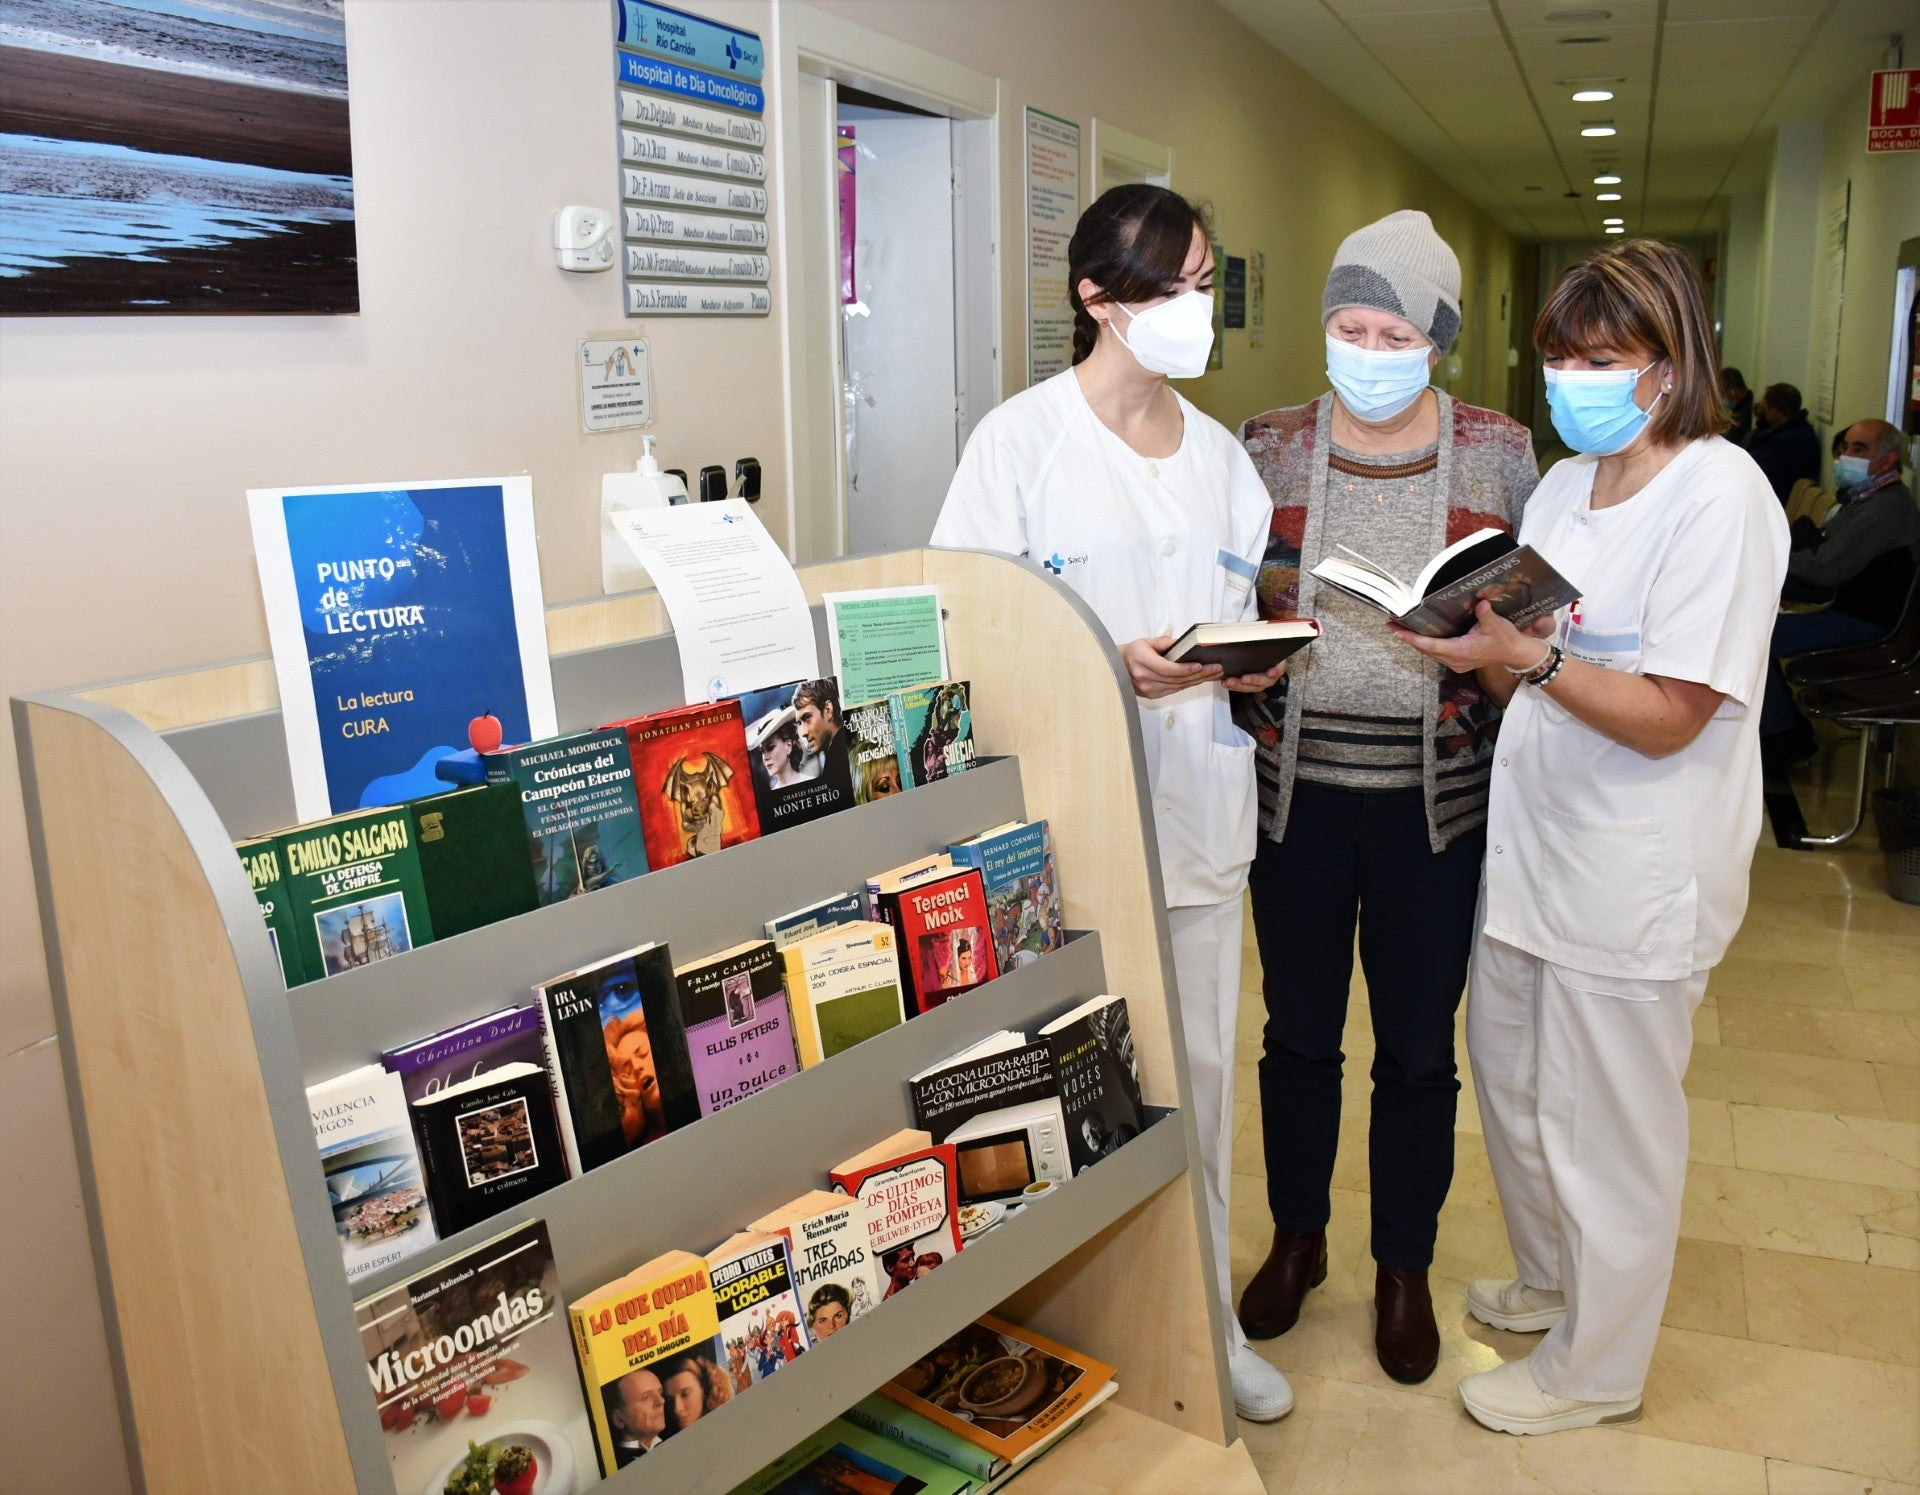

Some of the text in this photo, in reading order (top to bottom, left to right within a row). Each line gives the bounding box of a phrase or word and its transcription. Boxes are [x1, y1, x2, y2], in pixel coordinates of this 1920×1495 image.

[656, 18, 686, 37] Hospital
[670, 39, 696, 57] Carrión
[629, 59, 673, 86] Hospital
[675, 72, 687, 89] de
[1871, 129, 1903, 140] BOCA
[317, 557, 395, 584] PUNTO
[1067, 554, 1089, 566] Sacyl
[1460, 556, 1521, 594] ANDREWS
[322, 587, 349, 610] de
[324, 605, 425, 635] LECTURA
[337, 688, 414, 711] La lectura
[342, 717, 391, 738] CURA
[639, 711, 733, 743] JONATHAN STROUD
[520, 737, 623, 769] MICHAEL MOORCOCK
[942, 739, 976, 767] SUECIA
[534, 759, 593, 785] Crónicas
[594, 753, 615, 771] del
[946, 761, 977, 774] INFIERNO
[521, 767, 631, 803] Campeón Eterno
[783, 783, 828, 802] CHARLES FRAZIER
[538, 785, 622, 814] EL ETERNO
[580, 797, 623, 816] OBSIDIANA
[773, 788, 840, 818] MONTE FRÍO
[532, 829, 544, 840] EL
[581, 818, 592, 830] EN
[605, 805, 634, 822] ESPADA
[286, 819, 409, 876] EMILIO SALGARI
[983, 831, 1041, 858] BERNARD CORNWELL
[986, 860, 994, 872] El
[995, 858, 1005, 870] rey
[1006, 853, 1016, 865] del
[1017, 845, 1042, 861] invierno
[321, 861, 383, 886] LA DEFENSA
[326, 872, 381, 896] DE CHIPRE
[912, 882, 971, 915] Terenci
[924, 906, 965, 931] Moix
[810, 957, 893, 983] UNA ODISEA ESPACIAL
[554, 988, 576, 1007] IRA
[811, 980, 826, 991] 2001
[844, 978, 897, 995] ARTHUR CLARKE
[557, 996, 594, 1022] LEVIN
[416, 1017, 523, 1065] Christina Dodd
[706, 1017, 780, 1057] ELLIS PETERS
[1060, 1050, 1100, 1079] POR SI LAS
[920, 1084, 936, 1099] LA
[935, 1069, 977, 1093] COCINA
[933, 1063, 1040, 1106] CON MICROONDAS II
[1063, 1065, 1102, 1098] VOCES
[312, 1094, 377, 1122] VALENCIA
[461, 1097, 484, 1110] Camilo
[502, 1089, 517, 1099] Cela
[710, 1088, 733, 1104] un
[938, 1107, 945, 1116] de
[974, 1092, 989, 1105] para
[1066, 1084, 1105, 1115] VUELVEN
[483, 1175, 528, 1197] La colmena
[874, 1165, 926, 1188] Grandes Aventuras
[801, 1218, 824, 1234] Erich
[867, 1196, 943, 1236] DE POMPEYA
[806, 1220, 848, 1241] Remarque
[346, 1251, 402, 1279] GUER ESPERT
[803, 1239, 837, 1264] TRES
[711, 1247, 775, 1287] PEDRO VOLTES
[410, 1268, 475, 1306] Marianne Kaltenbach
[714, 1262, 786, 1304] ADORABLE
[589, 1269, 708, 1337] LO QUE QUEDA
[732, 1286, 770, 1313] LOCA
[367, 1287, 544, 1396] Microondas
[622, 1328, 659, 1358] DEL
[659, 1310, 690, 1342] DÍA
[628, 1335, 691, 1368] KAZUO ISHIGURO
[421, 1369, 450, 1389] Variedad
[467, 1355, 477, 1366] de
[476, 1343, 499, 1361] recetas
[464, 1364, 497, 1386] exclusivas
[401, 1401, 411, 1412] de
[411, 1396, 419, 1407] la
[419, 1385, 440, 1403] cocina
